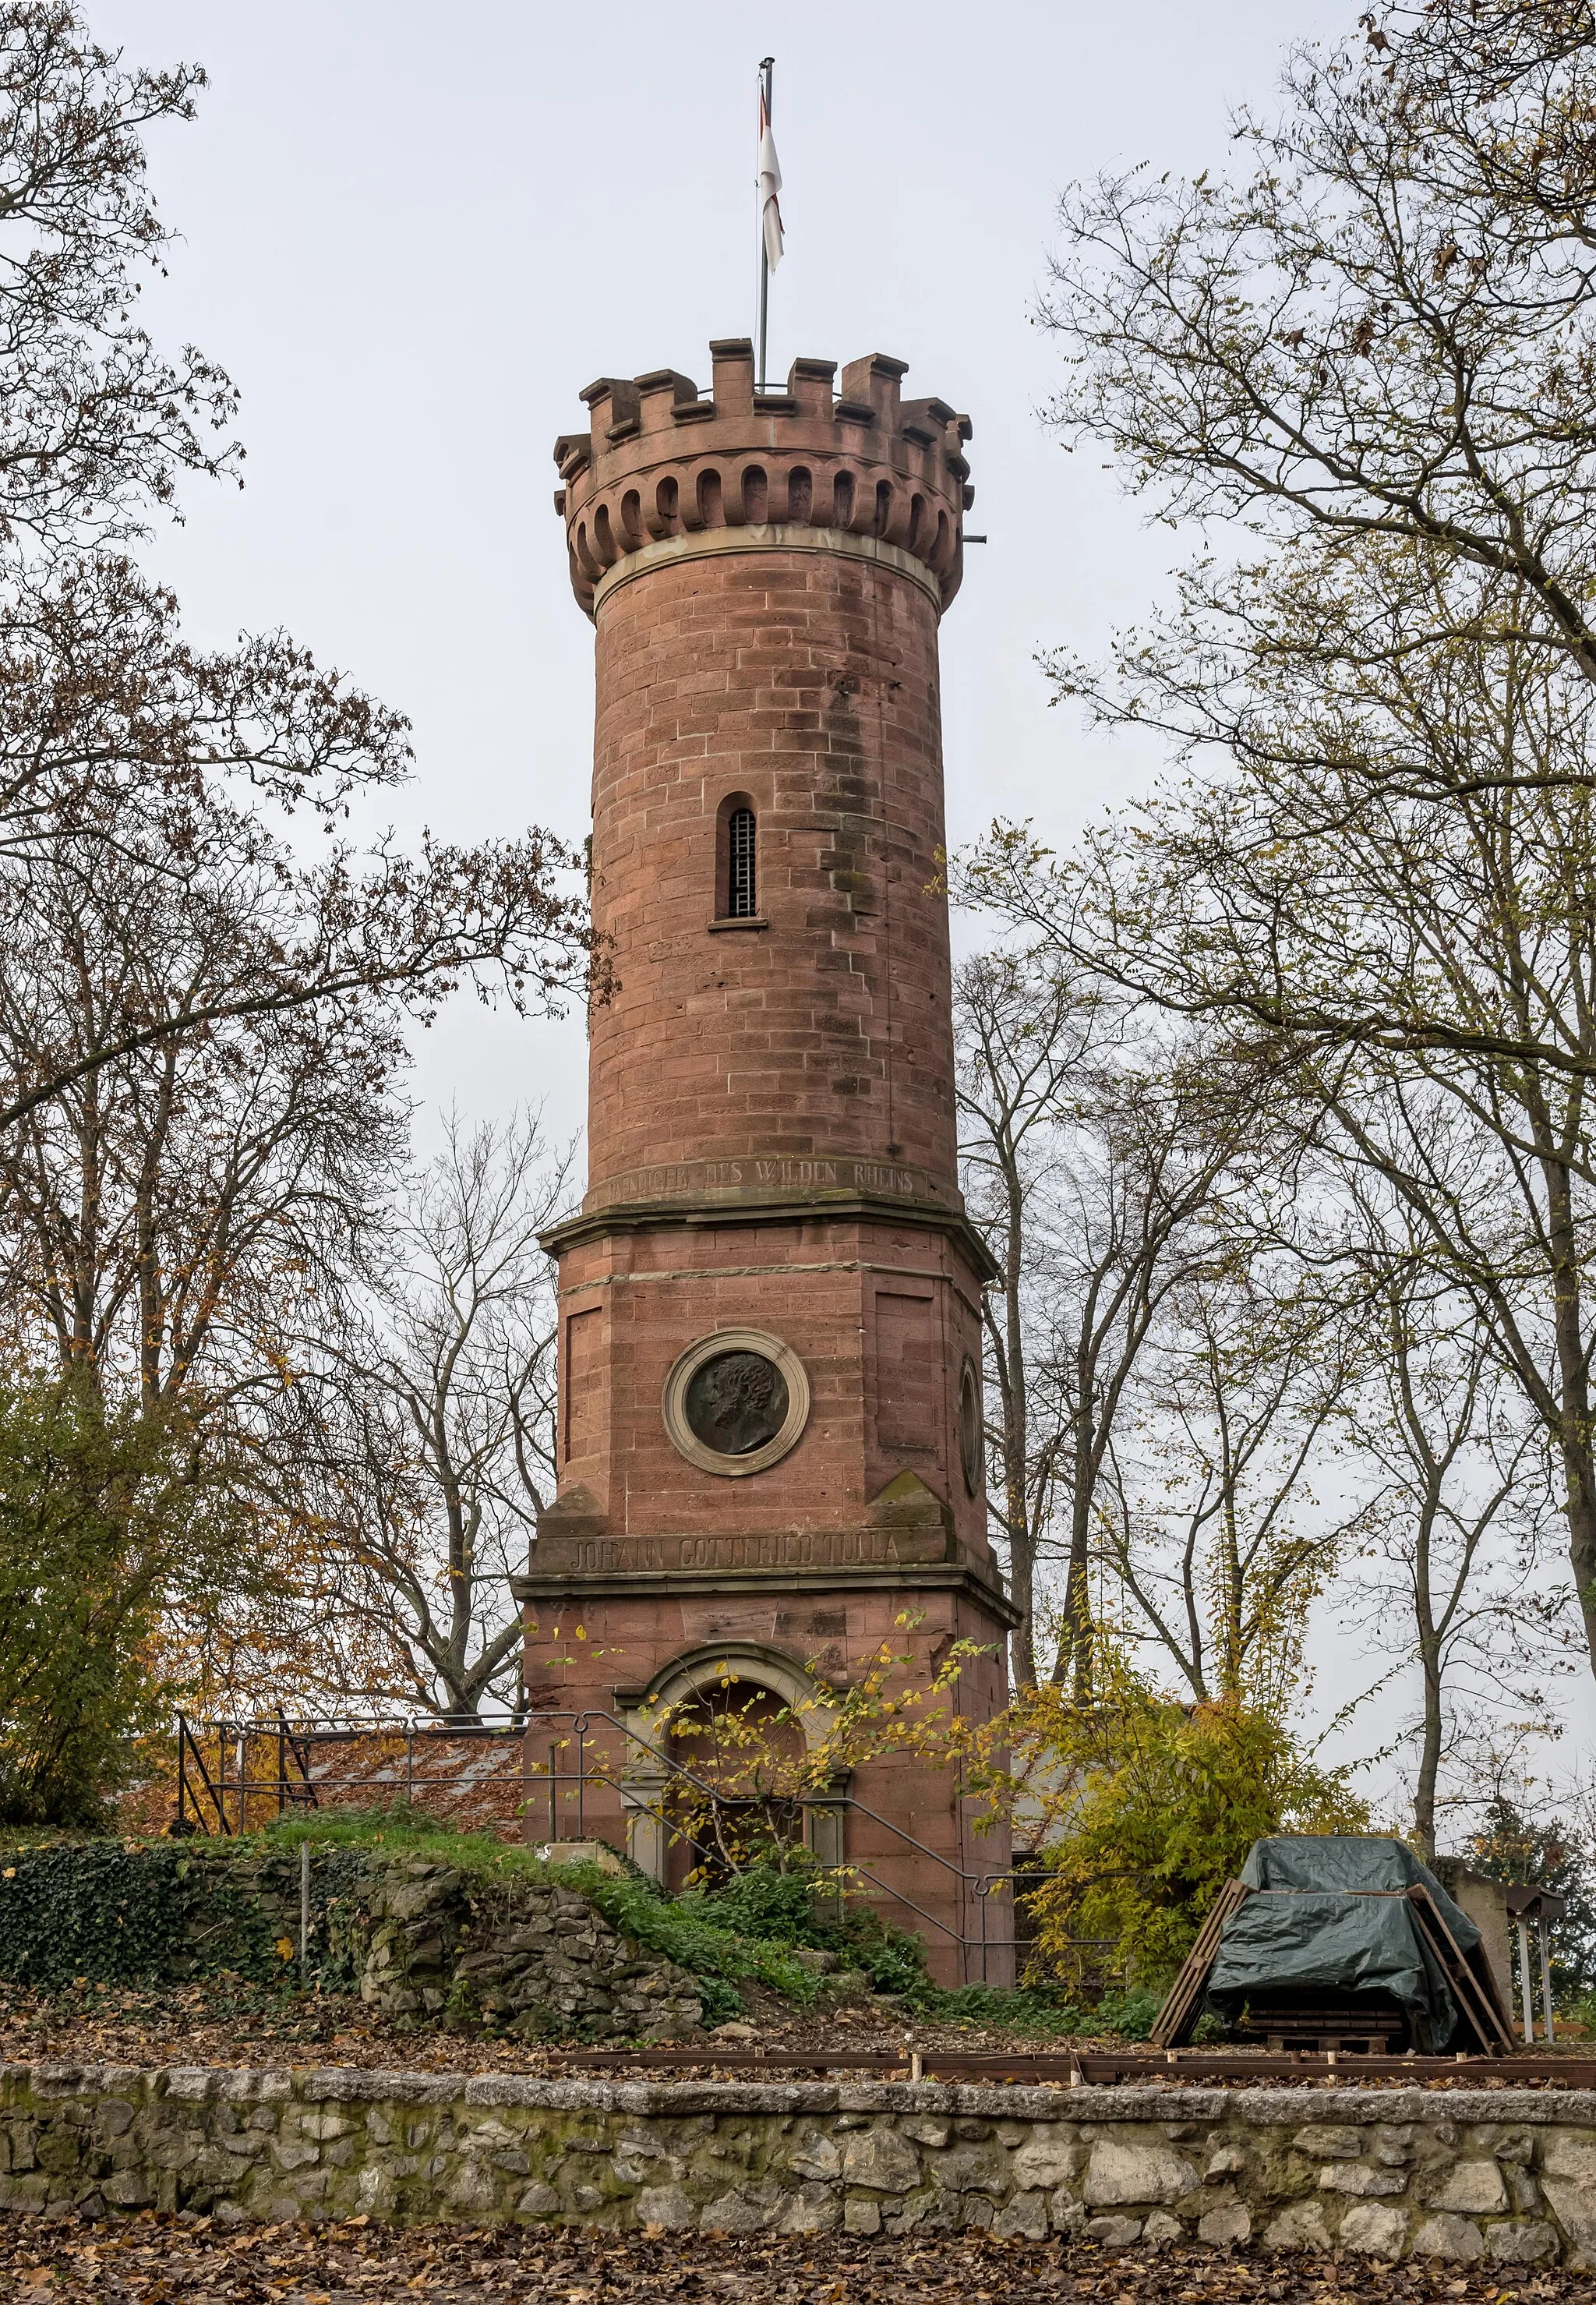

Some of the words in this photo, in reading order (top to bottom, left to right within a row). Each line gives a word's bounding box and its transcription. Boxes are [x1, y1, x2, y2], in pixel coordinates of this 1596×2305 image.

[704, 1162, 743, 1183] DES
[756, 1161, 837, 1183] WILDEN
[853, 1164, 913, 1192] RHEINS
[570, 1540, 665, 1569] JOHANN
[679, 1535, 814, 1567] GOTTFRIED
[823, 1534, 900, 1561] TULLA
